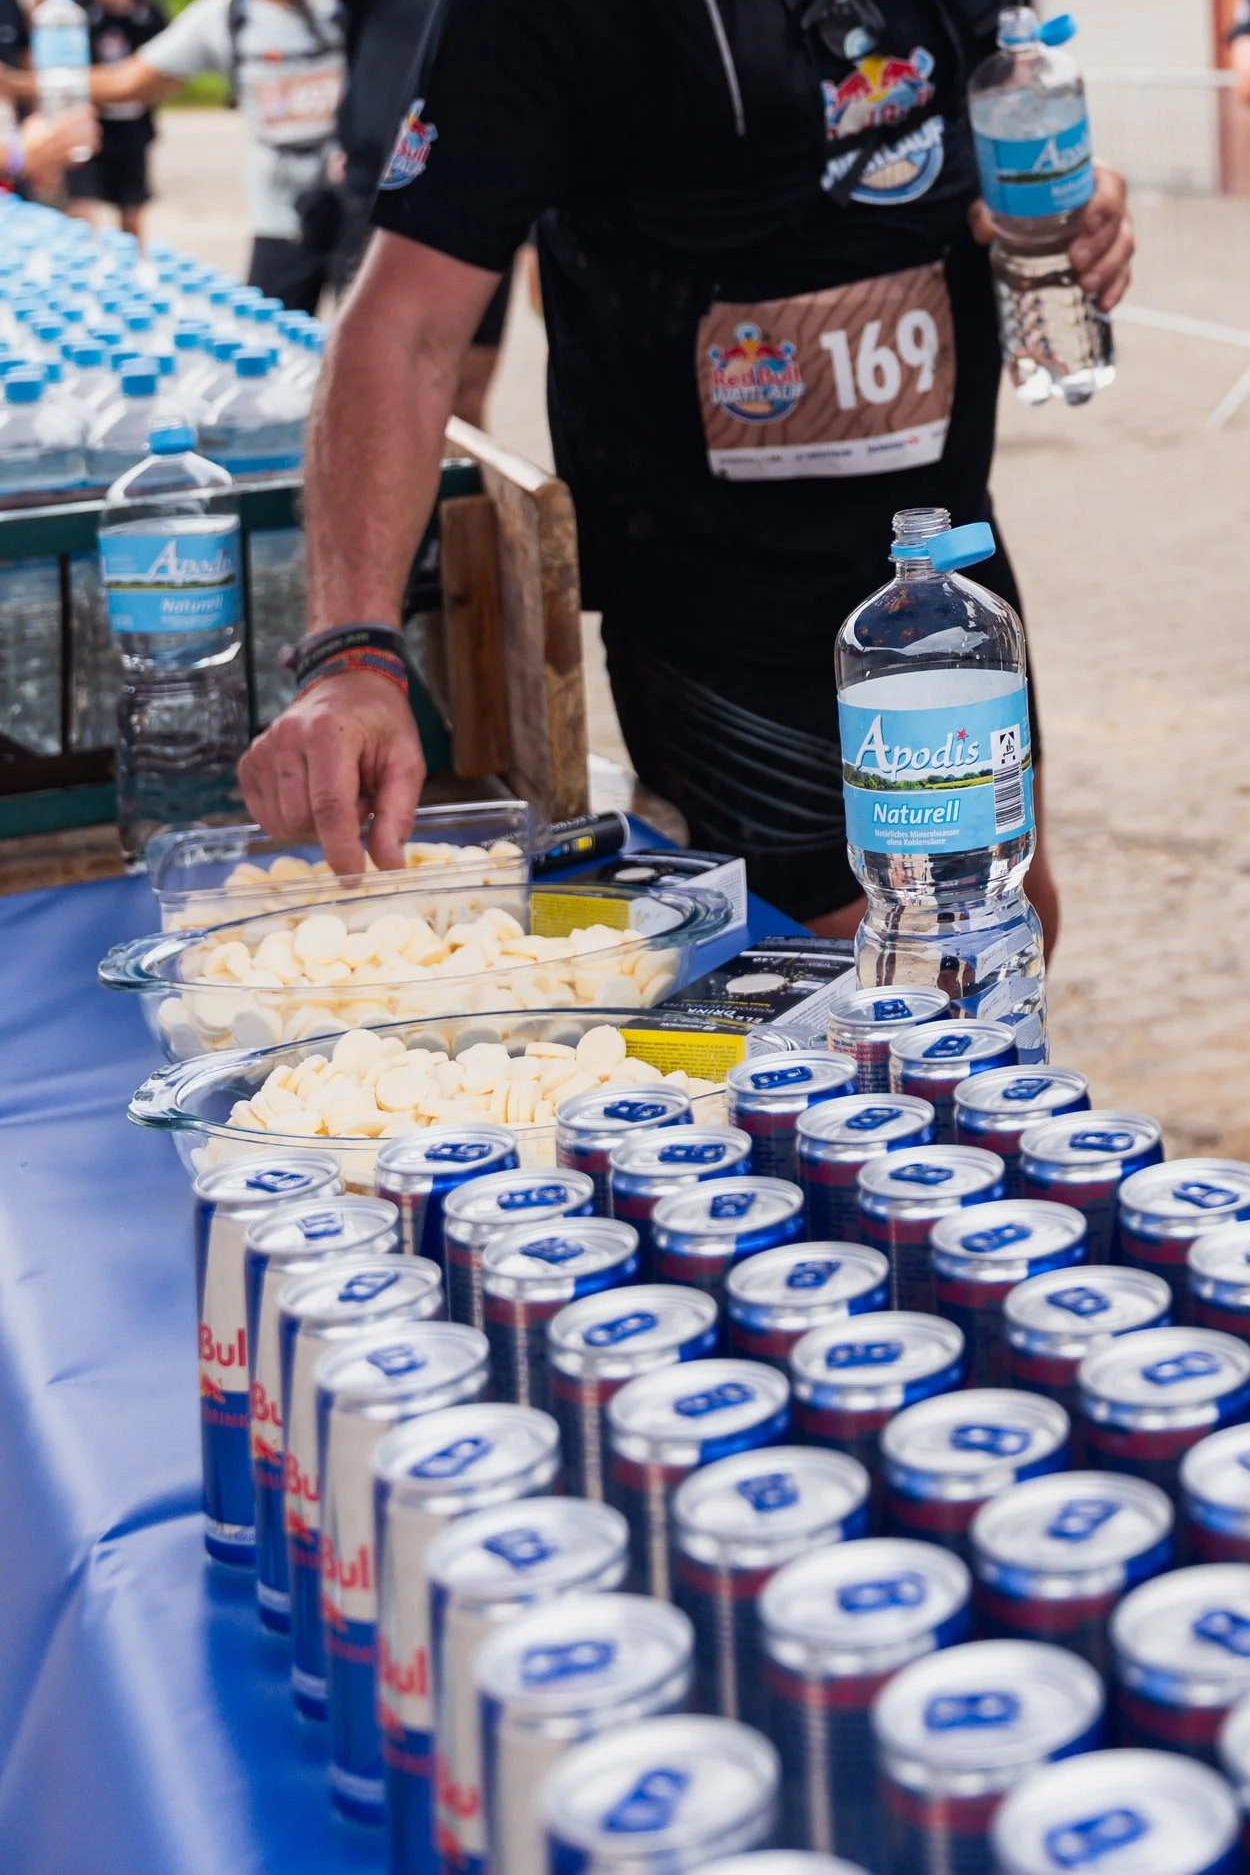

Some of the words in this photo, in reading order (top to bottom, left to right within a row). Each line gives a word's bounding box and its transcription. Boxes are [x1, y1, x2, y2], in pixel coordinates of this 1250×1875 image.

[819, 310, 939, 411] 169
[854, 713, 980, 784] Apodis
[873, 799, 961, 825] Naturell
[910, 828, 960, 838] Mineralwasser
[199, 1322, 246, 1367] Bul
